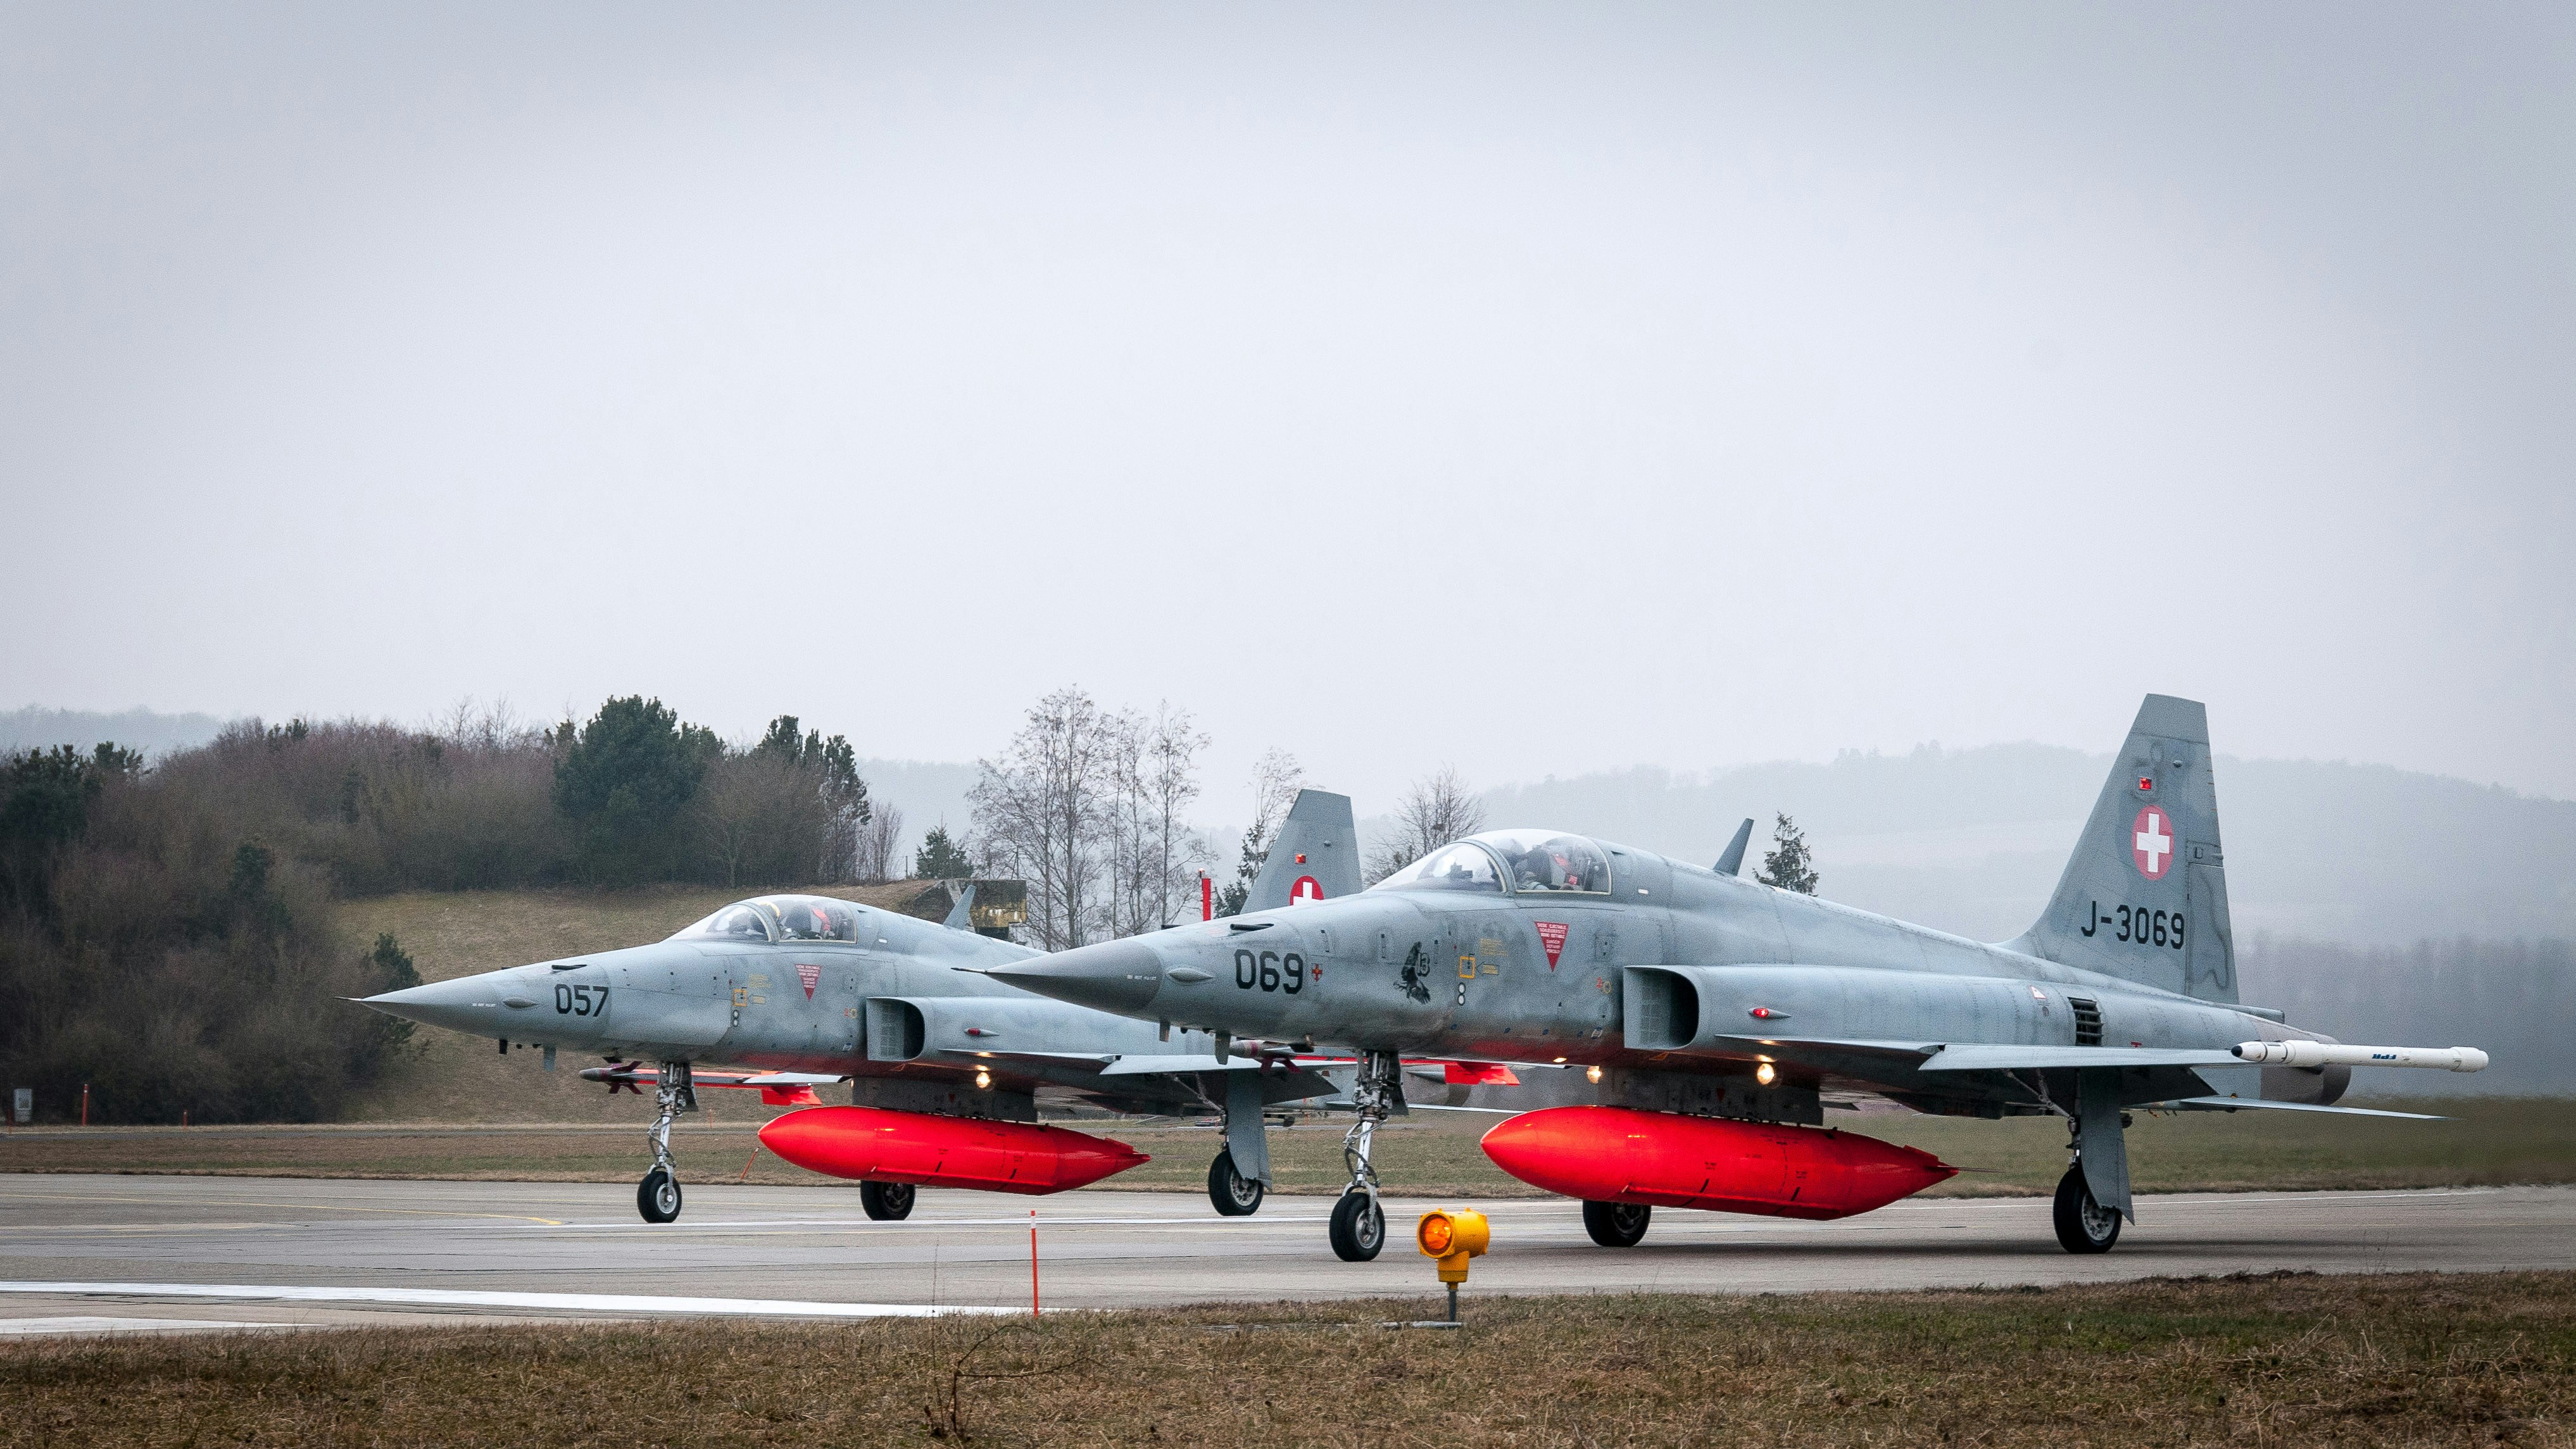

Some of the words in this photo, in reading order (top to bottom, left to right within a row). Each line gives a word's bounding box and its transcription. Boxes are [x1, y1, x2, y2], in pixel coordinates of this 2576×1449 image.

[2081, 901, 2185, 950] J-3069
[1234, 949, 1304, 994] 069
[555, 984, 608, 1017] 057
